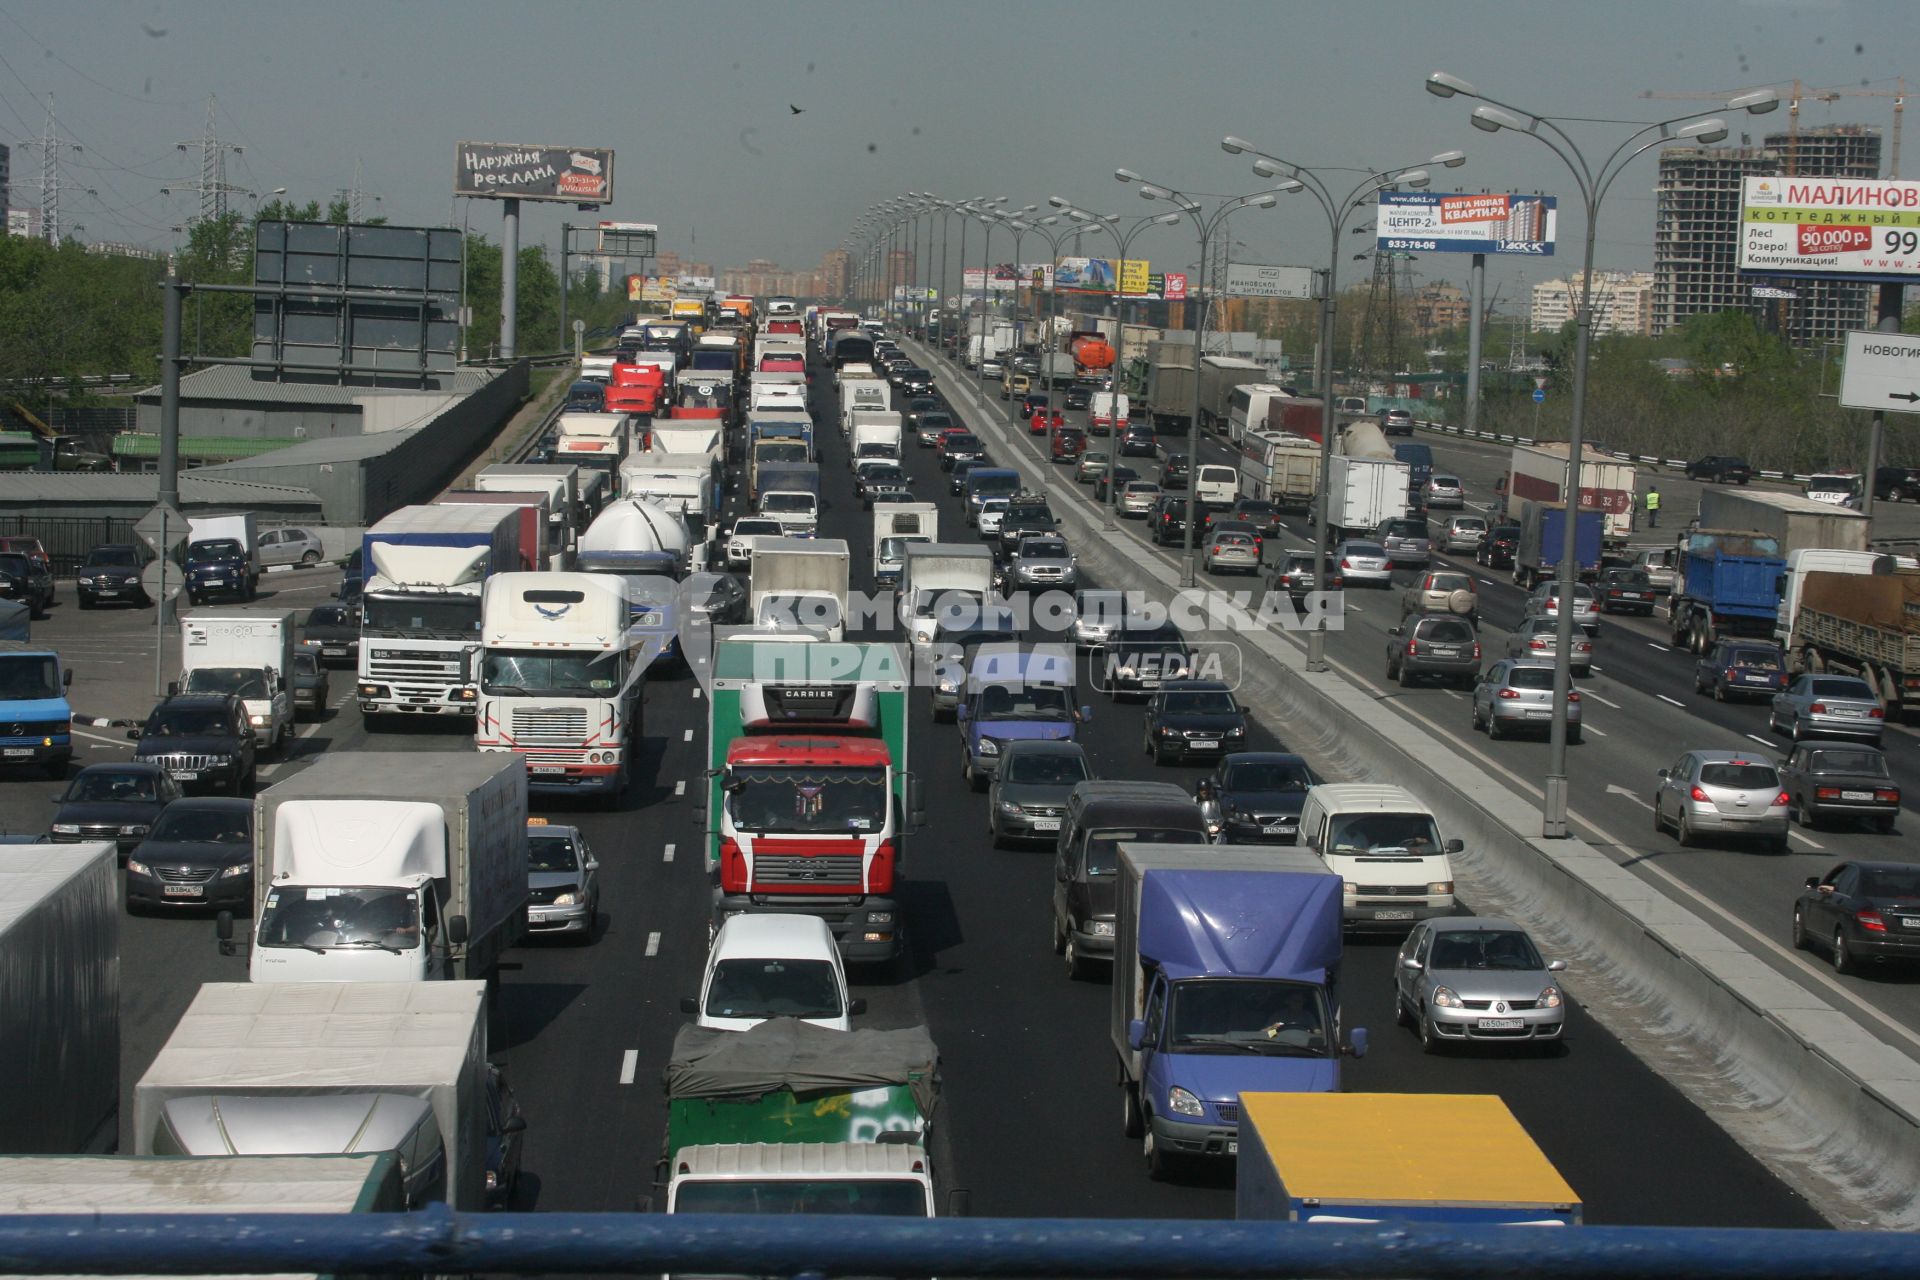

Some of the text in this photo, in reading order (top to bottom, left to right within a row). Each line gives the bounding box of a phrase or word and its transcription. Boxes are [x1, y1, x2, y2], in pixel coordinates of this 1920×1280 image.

[1390, 196, 1436, 204] www.dsk1.ru
[1444, 198, 1505, 210] ВАША НОВАЯ
[1445, 207, 1506, 220] КВАРТИРА
[1752, 210, 1901, 224] коттеджный
[1749, 229, 1773, 238] Лес!
[1801, 230, 1869, 247] 90 000 р.
[1749, 242, 1788, 252] Озеро!
[1748, 254, 1838, 266] Коммуникации!
[1230, 280, 1276, 288] ИВАНОВСКОЕ
[801, 423, 811, 433] 52
[1582, 495, 1613, 507] 03 32
[1814, 492, 1841, 500] ДПС
[785, 690, 833, 698] CARRIER
